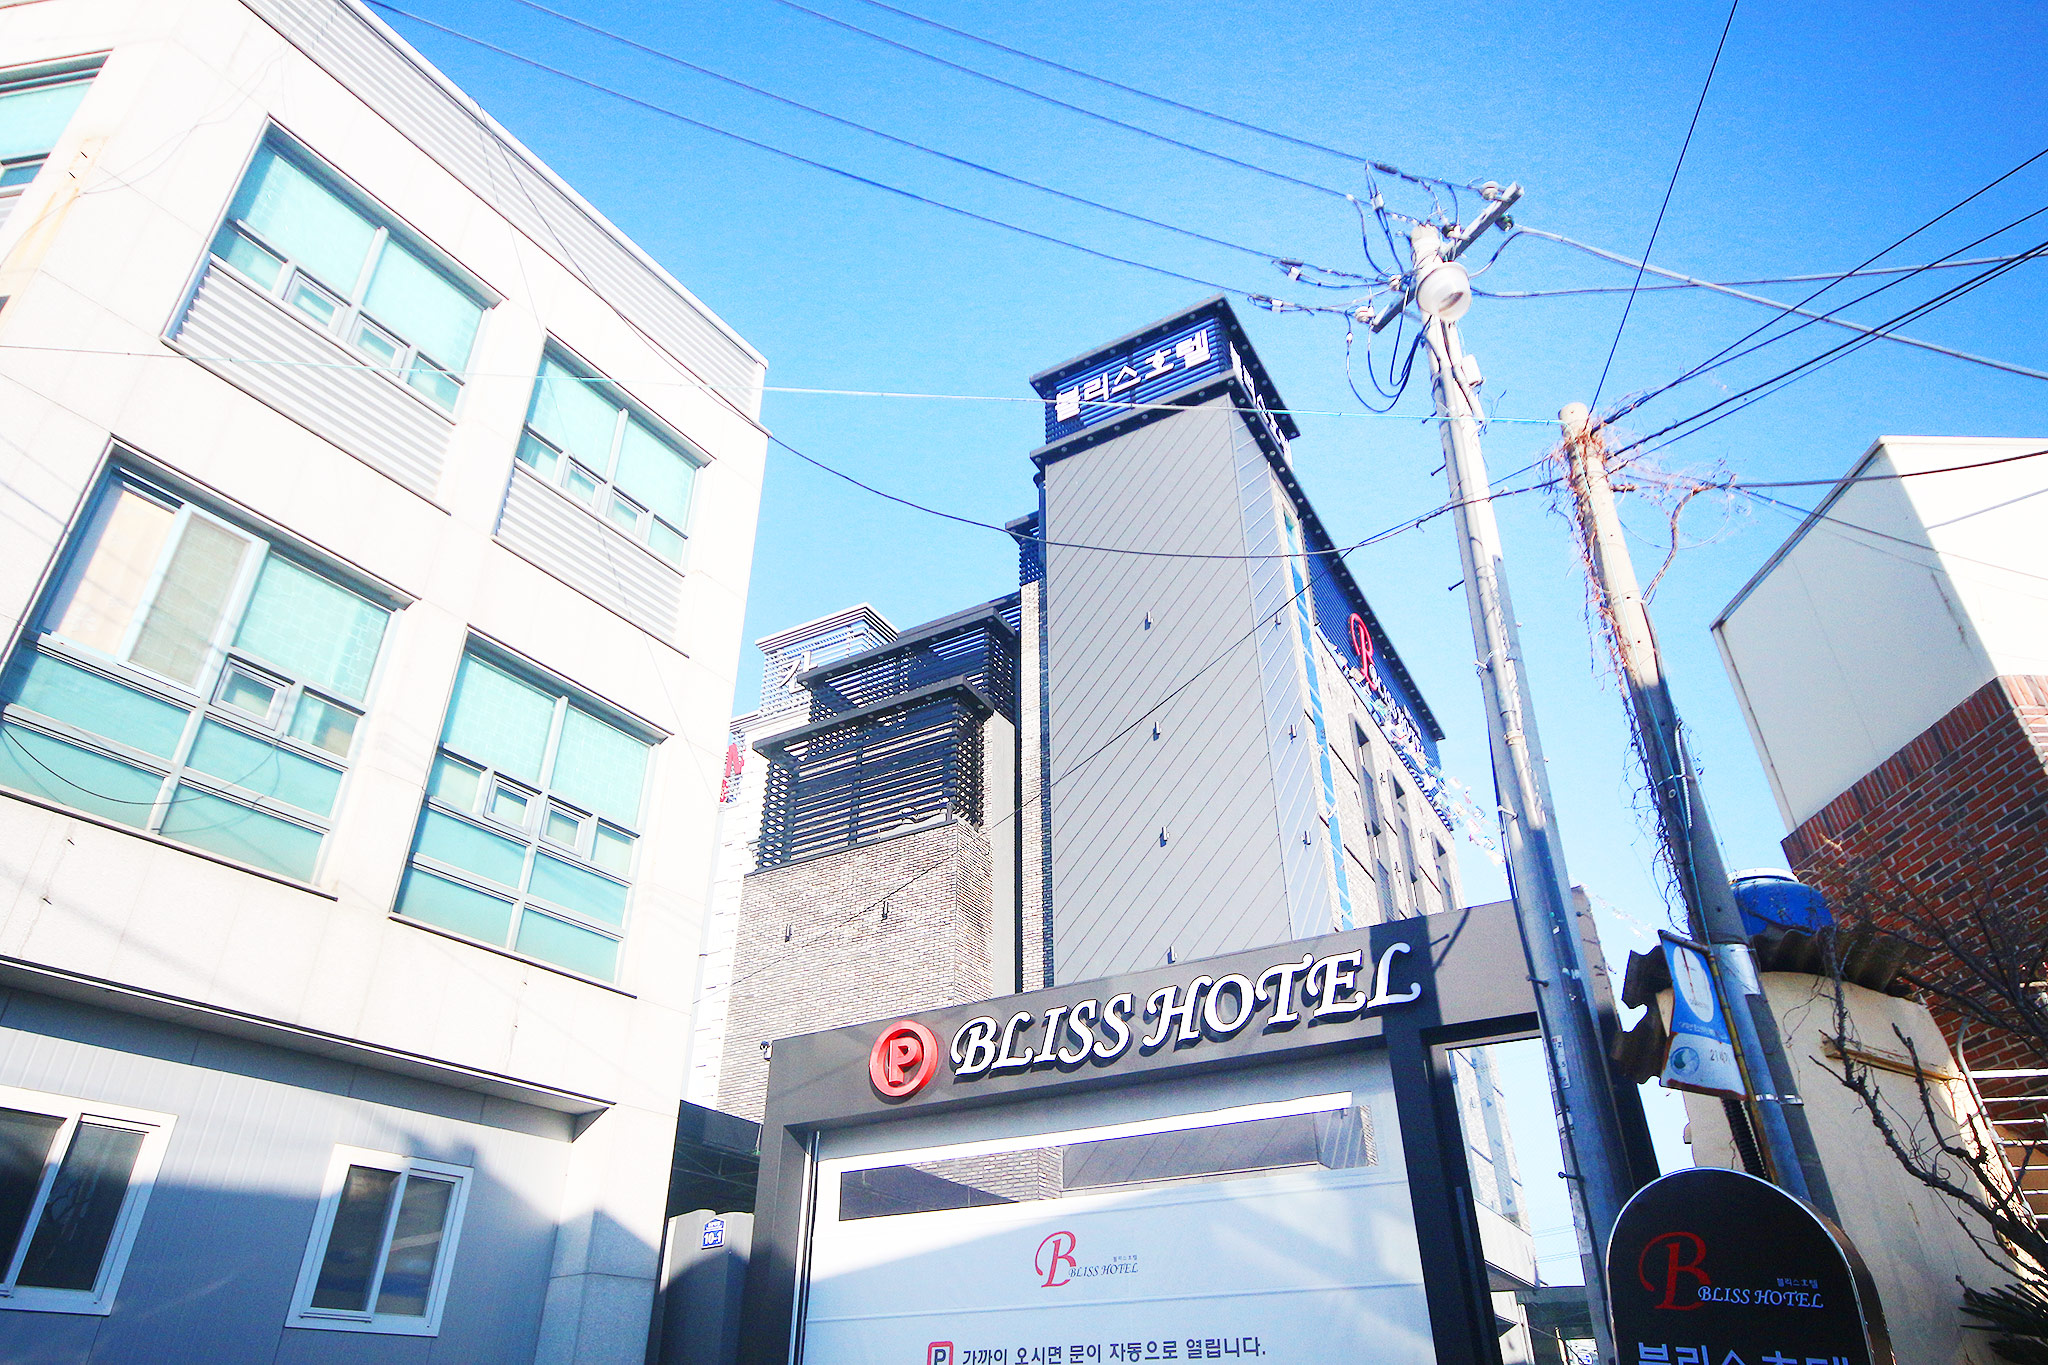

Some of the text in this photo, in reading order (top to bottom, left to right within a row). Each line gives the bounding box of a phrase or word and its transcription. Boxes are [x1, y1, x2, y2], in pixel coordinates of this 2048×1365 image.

[1054, 328, 1211, 422] 블리스호텔
[949, 941, 1423, 1078] BLISS HOTEL
[703, 1231, 723, 1245] 10-1
[1068, 1262, 1139, 1278] BLISS HOTEL
[1697, 1285, 1825, 1309] BLISS HOTEL
[962, 1336, 1266, 1365] 가까이 오시면 문이 자동으로 열립니다.
